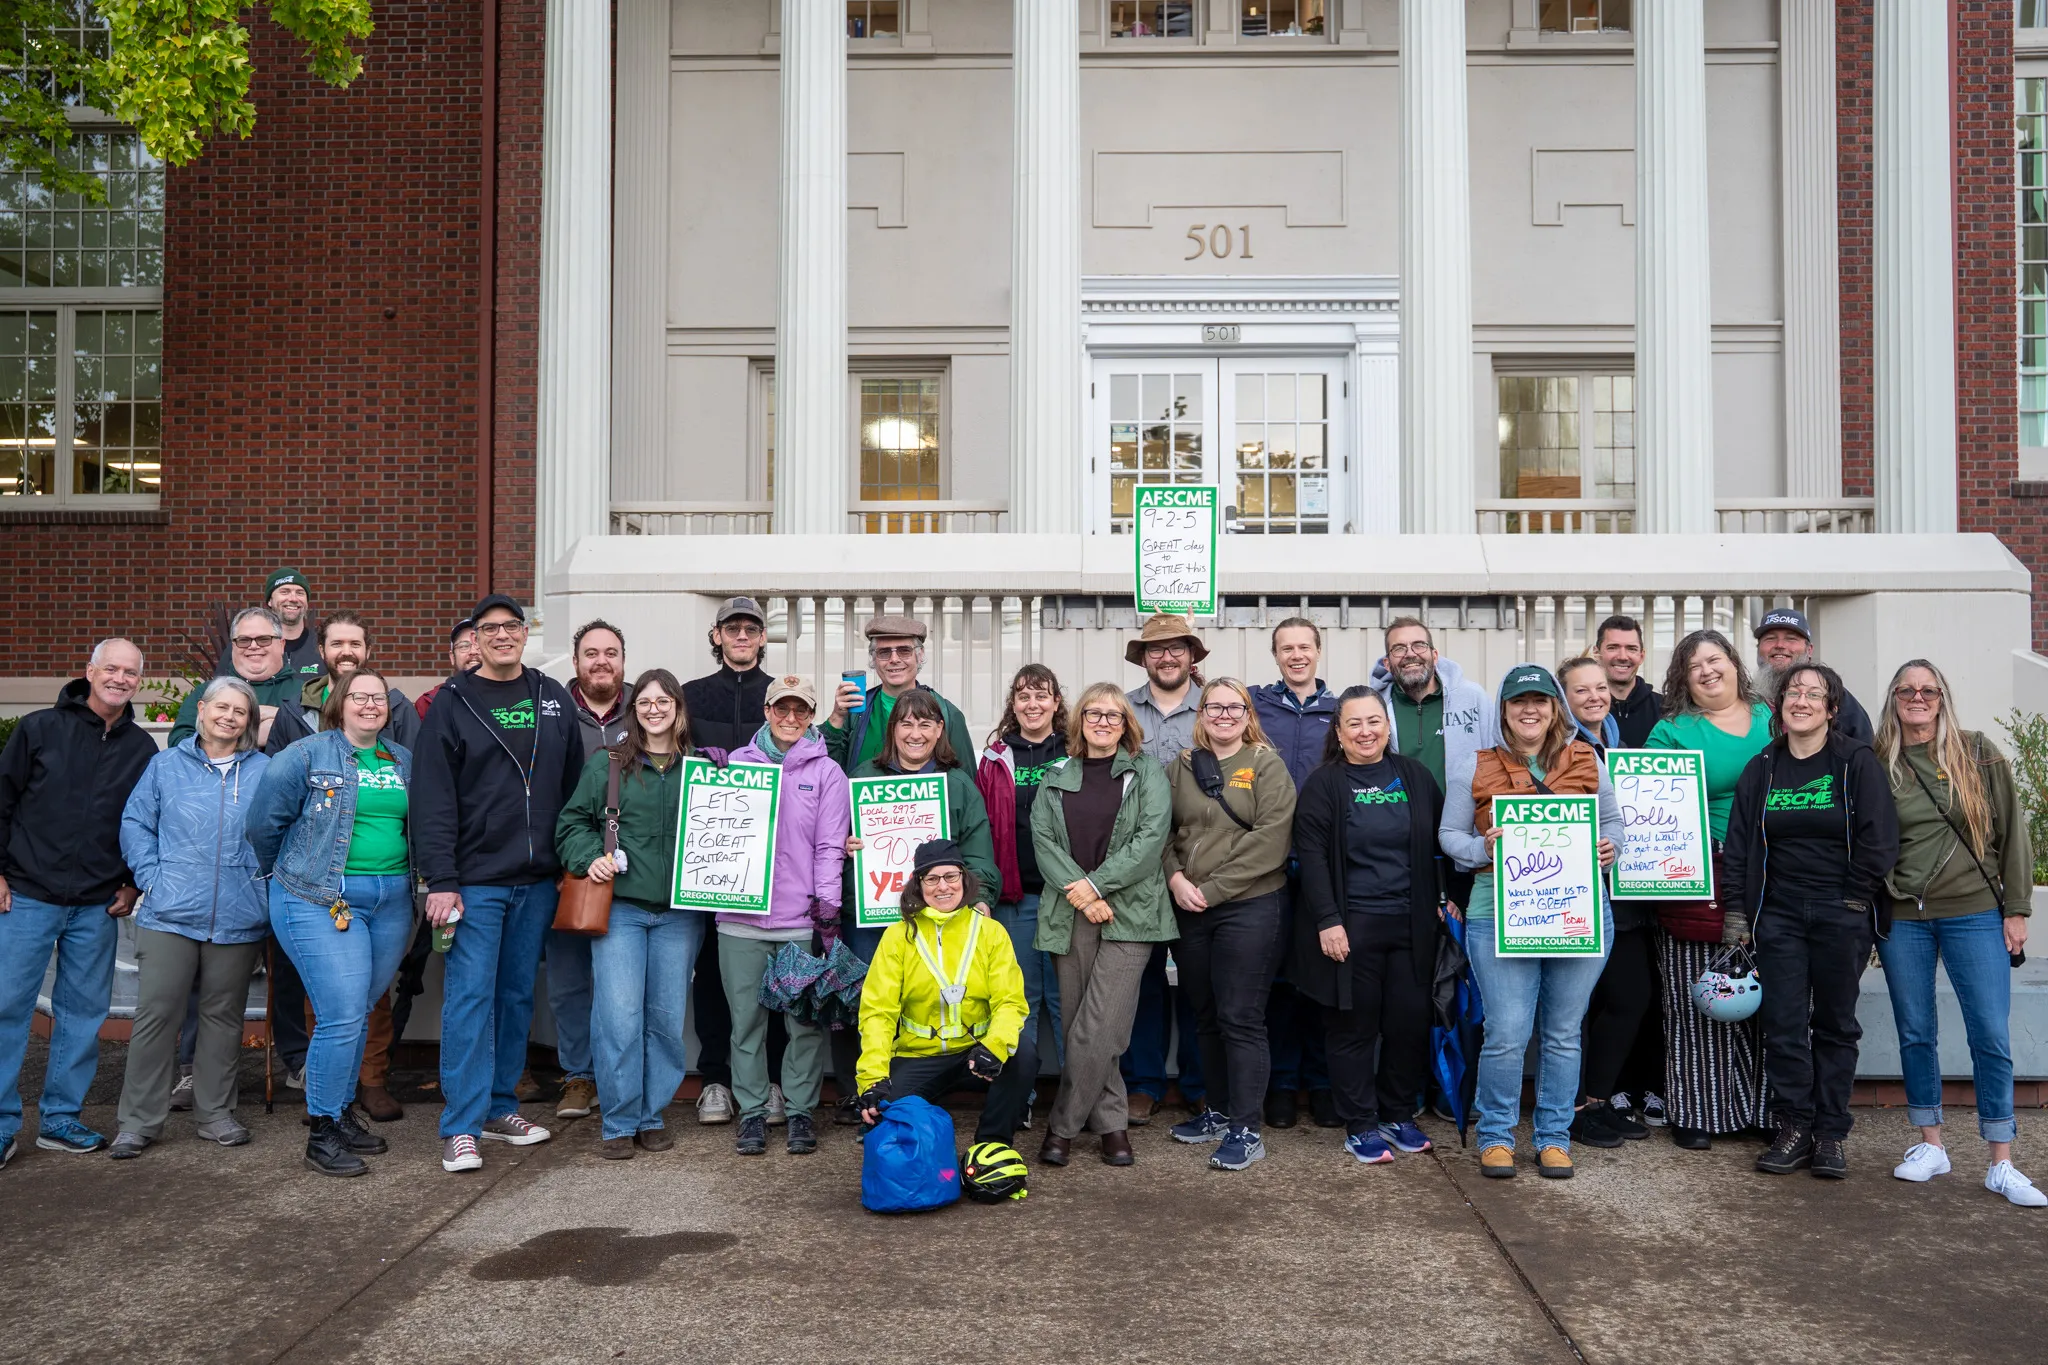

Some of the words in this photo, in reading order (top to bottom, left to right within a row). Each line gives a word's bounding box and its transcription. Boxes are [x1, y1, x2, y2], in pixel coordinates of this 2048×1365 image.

[1184, 224, 1254, 261] 501
[1207, 326, 1236, 341] 501
[1140, 490, 1212, 506] AFSCME
[1144, 508, 1196, 528] 9-2-5
[1142, 539, 1182, 553] GREAT
[1184, 540, 1205, 553] day
[1144, 563, 1184, 577] SETTLE
[1186, 562, 1206, 573] this
[1144, 578, 1206, 595] CONTRACT
[1614, 756, 1697, 774] AFSCME
[689, 765, 774, 788] AFSCME
[858, 782, 940, 803] AFSCME
[1354, 790, 1409, 804] AFSCM
[1621, 776, 1687, 802] 9-25
[689, 786, 750, 812] LET'S
[860, 806, 888, 816] LOCAL
[893, 804, 917, 814] 2975
[1502, 803, 1590, 822] AFSCME
[690, 815, 754, 830] SETTLE
[867, 815, 905, 827] STRIKE
[907, 814, 935, 825] VOTE
[1621, 805, 1678, 833] Dolly
[686, 832, 694, 848] A
[699, 832, 756, 848] GREAT
[1514, 826, 1571, 848] 9-25
[685, 852, 745, 864] CONTRACT
[1505, 851, 1563, 884] Dolly
[1659, 857, 1696, 876] Today
[869, 870, 913, 901] YE
[1508, 888, 1533, 897] WOULD
[1536, 887, 1560, 896] WANT
[1565, 887, 1575, 895] US
[680, 890, 715, 900] OREGON
[716, 893, 751, 903] COUNCIL
[753, 896, 763, 904] 75
[1537, 896, 1578, 910] GREAT
[864, 908, 898, 916] OREGON
[1508, 913, 1560, 927] CONTRACT
